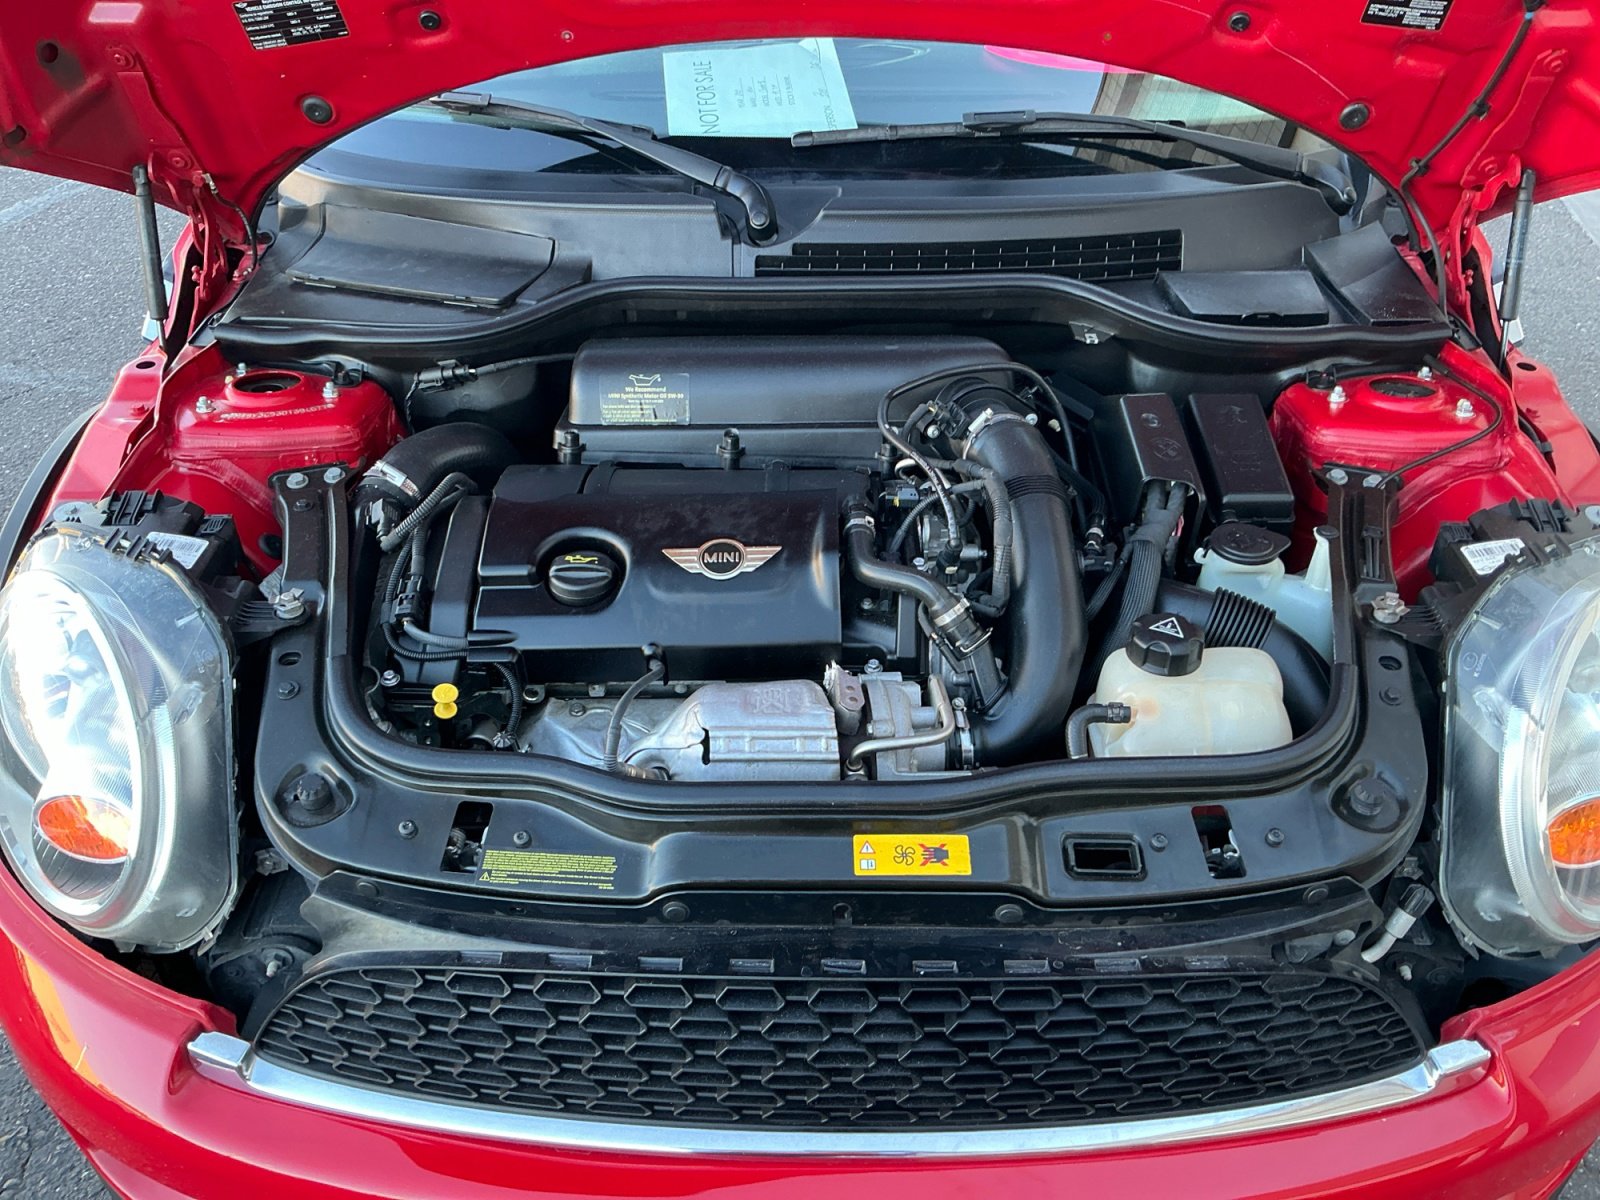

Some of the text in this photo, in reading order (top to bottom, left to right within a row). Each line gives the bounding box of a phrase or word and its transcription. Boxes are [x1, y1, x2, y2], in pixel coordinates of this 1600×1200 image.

[693, 60, 720, 134] NOT FOR SALE
[704, 551, 740, 563] MINI
